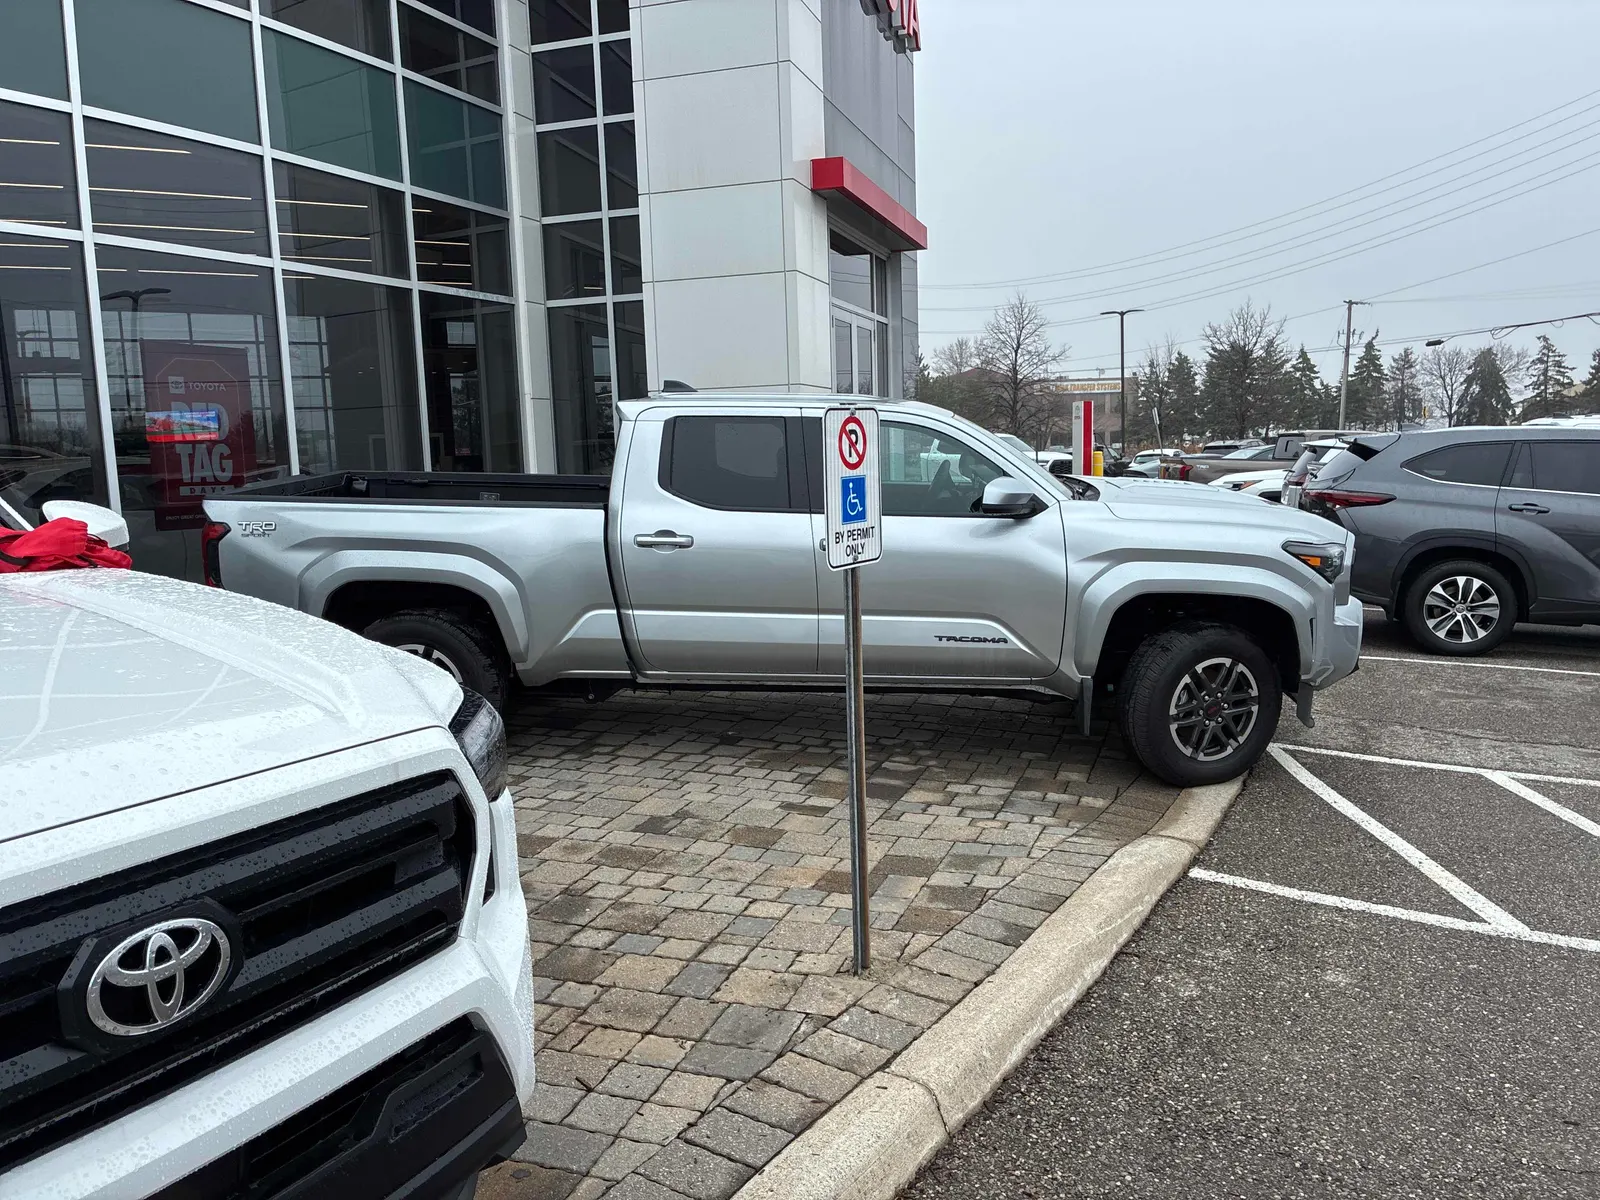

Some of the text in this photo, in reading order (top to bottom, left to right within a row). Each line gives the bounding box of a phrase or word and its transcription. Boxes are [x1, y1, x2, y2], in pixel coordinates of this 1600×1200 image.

[188, 382, 226, 391] TOYOTA
[171, 401, 230, 441] RED
[175, 443, 233, 483] TAG
[189, 486, 226, 495] DAYS
[237, 521, 277, 534] TRD
[835, 526, 875, 544] BY PERMIT
[845, 542, 866, 557] ONLY
[934, 635, 1009, 644] TACOMA
